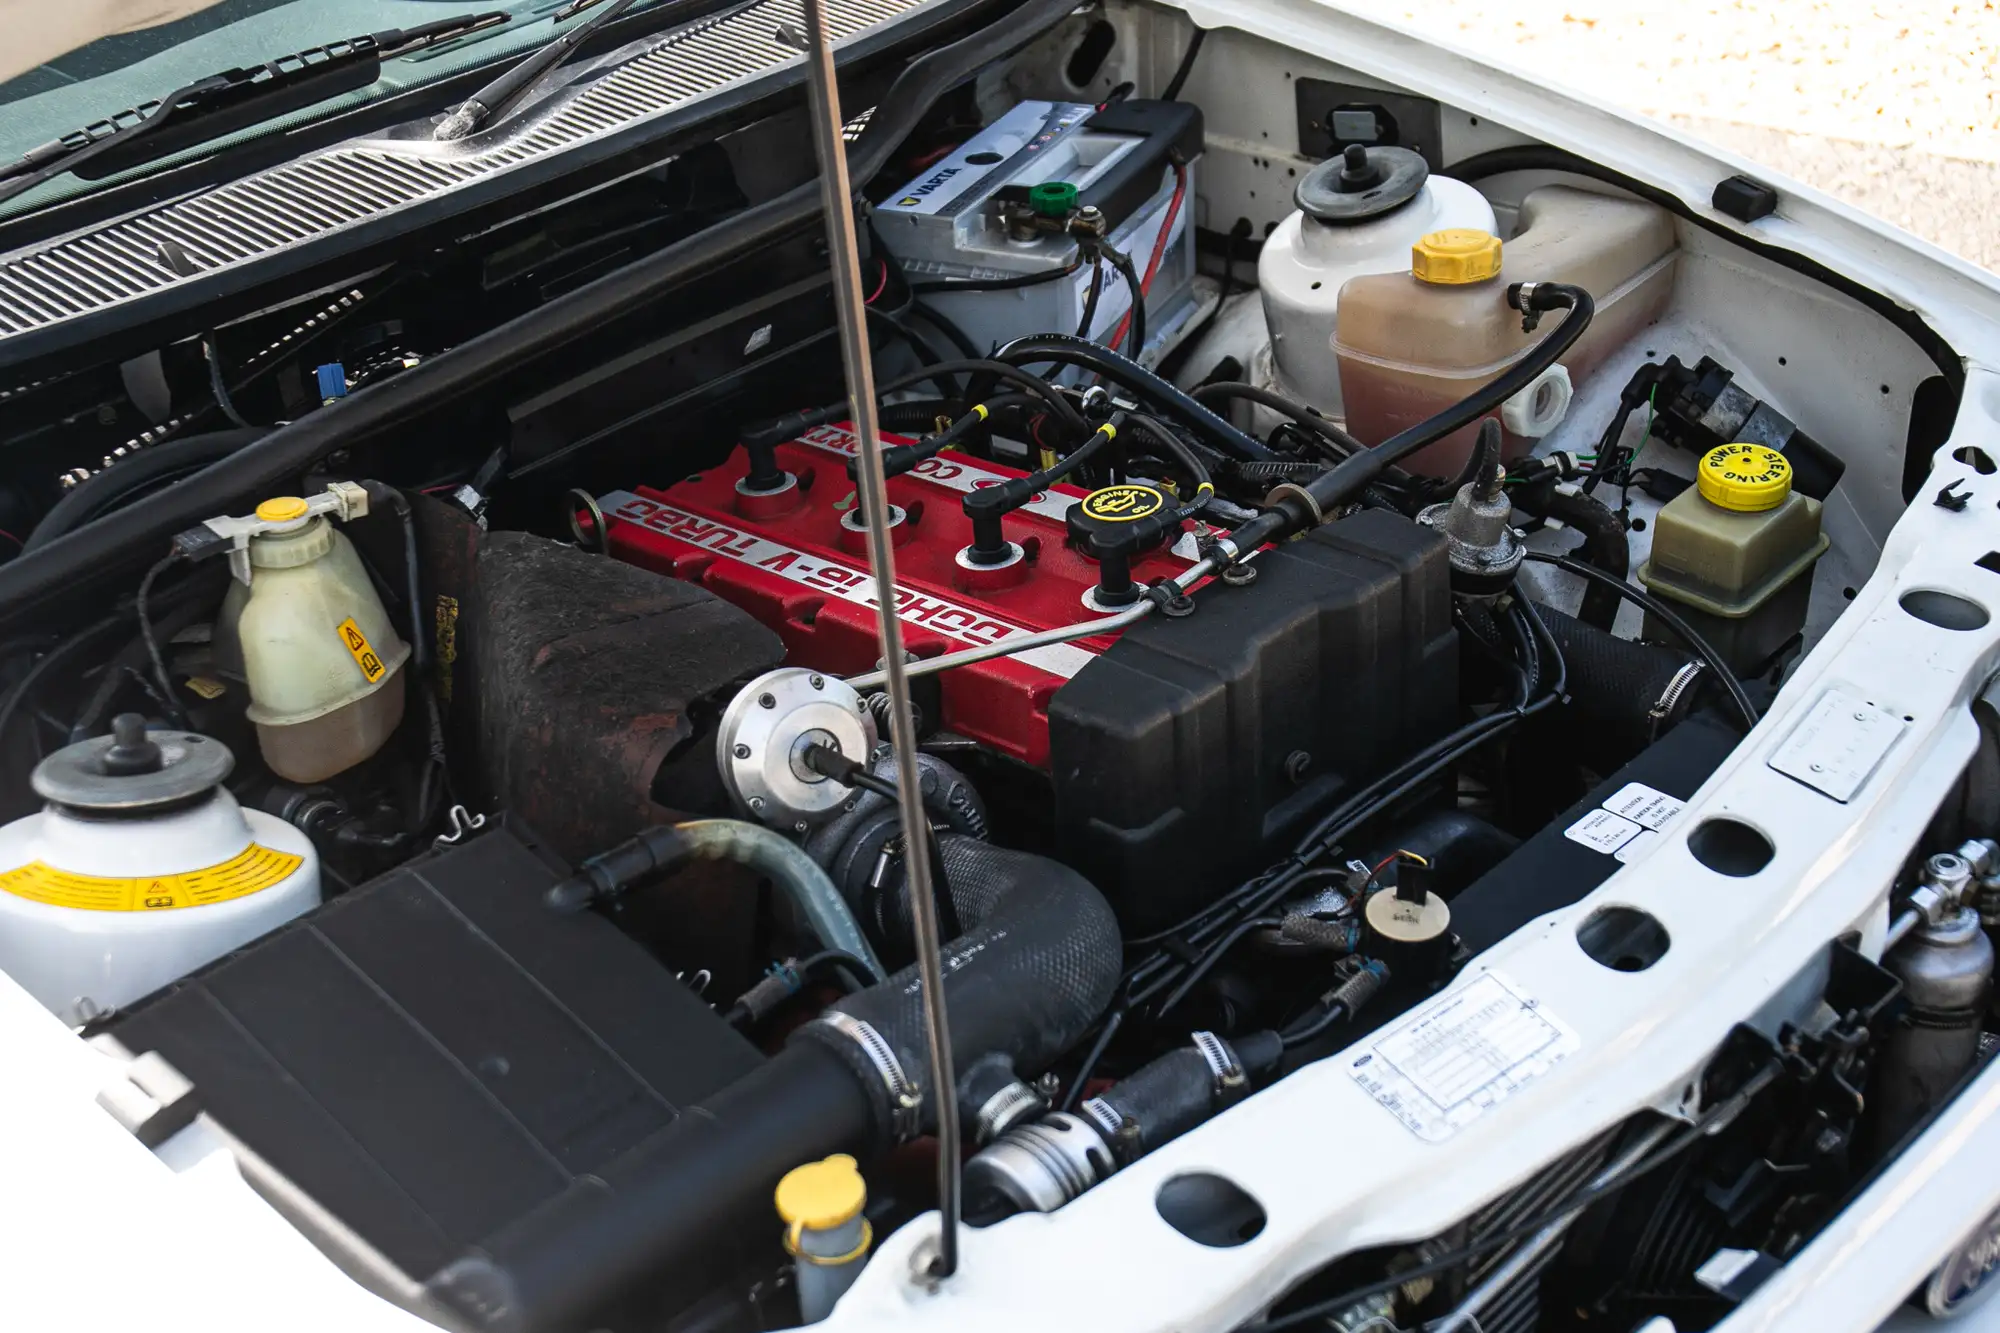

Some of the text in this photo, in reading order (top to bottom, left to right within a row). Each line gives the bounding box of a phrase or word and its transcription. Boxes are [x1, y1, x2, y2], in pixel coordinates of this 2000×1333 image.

[909, 168, 962, 195] VARTA
[1710, 446, 1785, 483] POWER STEERING
[1092, 489, 1131, 507] ENGINE
[1131, 504, 1150, 514] OIL
[616, 499, 760, 557] TURBO
